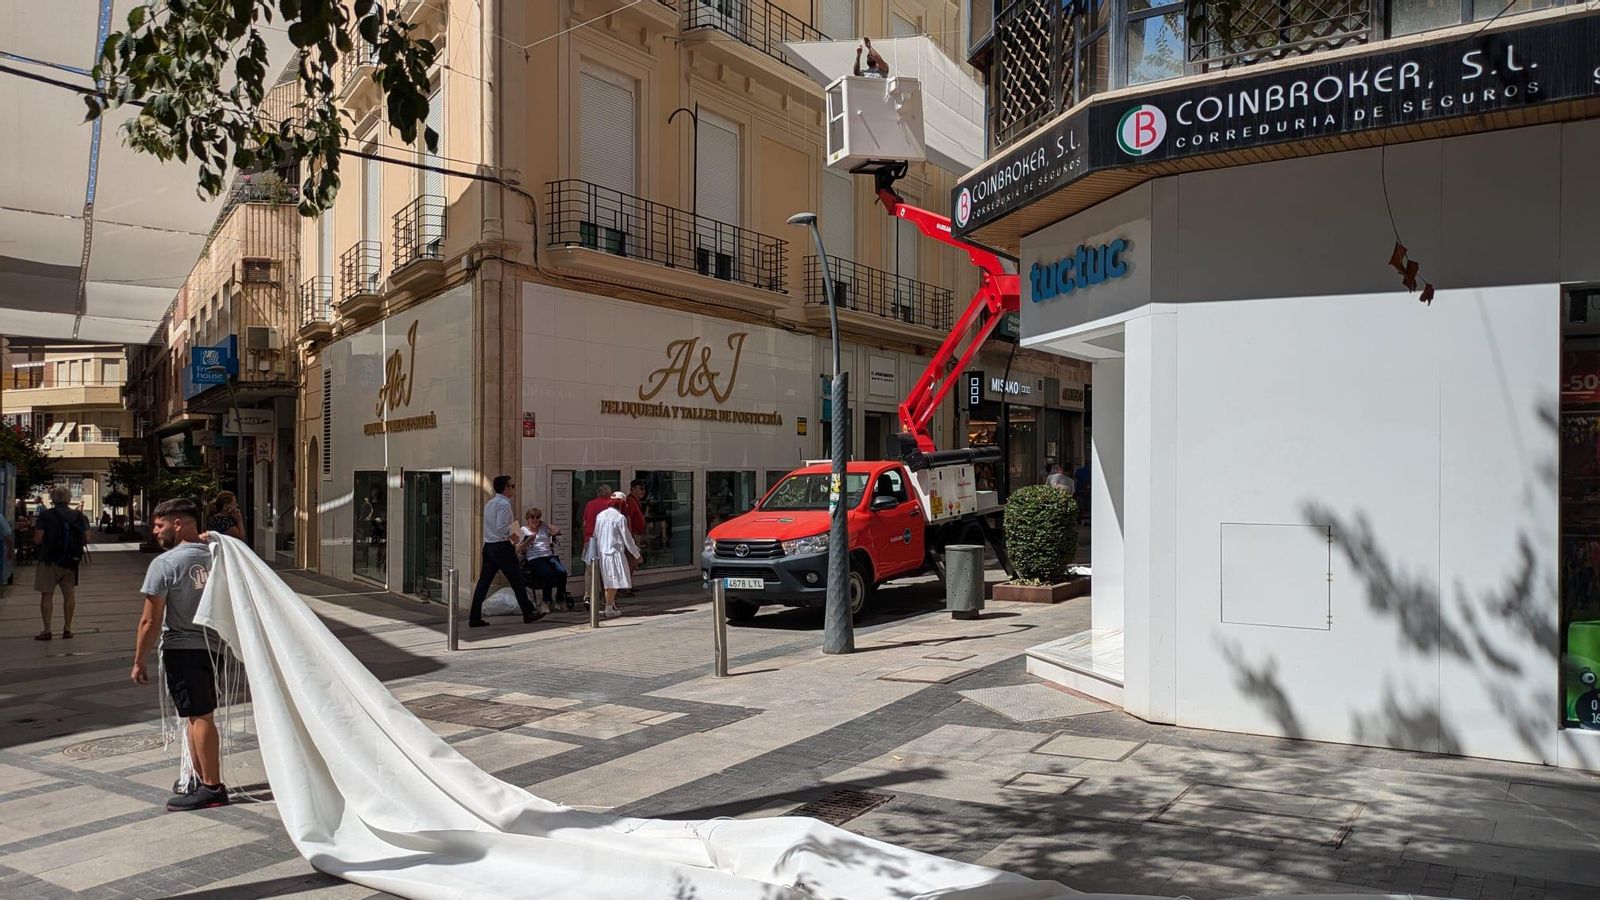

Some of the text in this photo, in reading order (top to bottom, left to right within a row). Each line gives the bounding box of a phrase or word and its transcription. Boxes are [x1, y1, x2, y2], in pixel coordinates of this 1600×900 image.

[1176, 81, 1540, 149] CORREDURIA DE SEGUROS
[1023, 181, 1034, 194] DE
[1038, 156, 1081, 186] SEGUROS
[638, 332, 749, 404] A&J
[1563, 374, 1600, 391] -50
[600, 399, 783, 426] PELUQUERÍA Y TALLER DE POSTICERÍA
[729, 579, 763, 588] 4678 LYL
